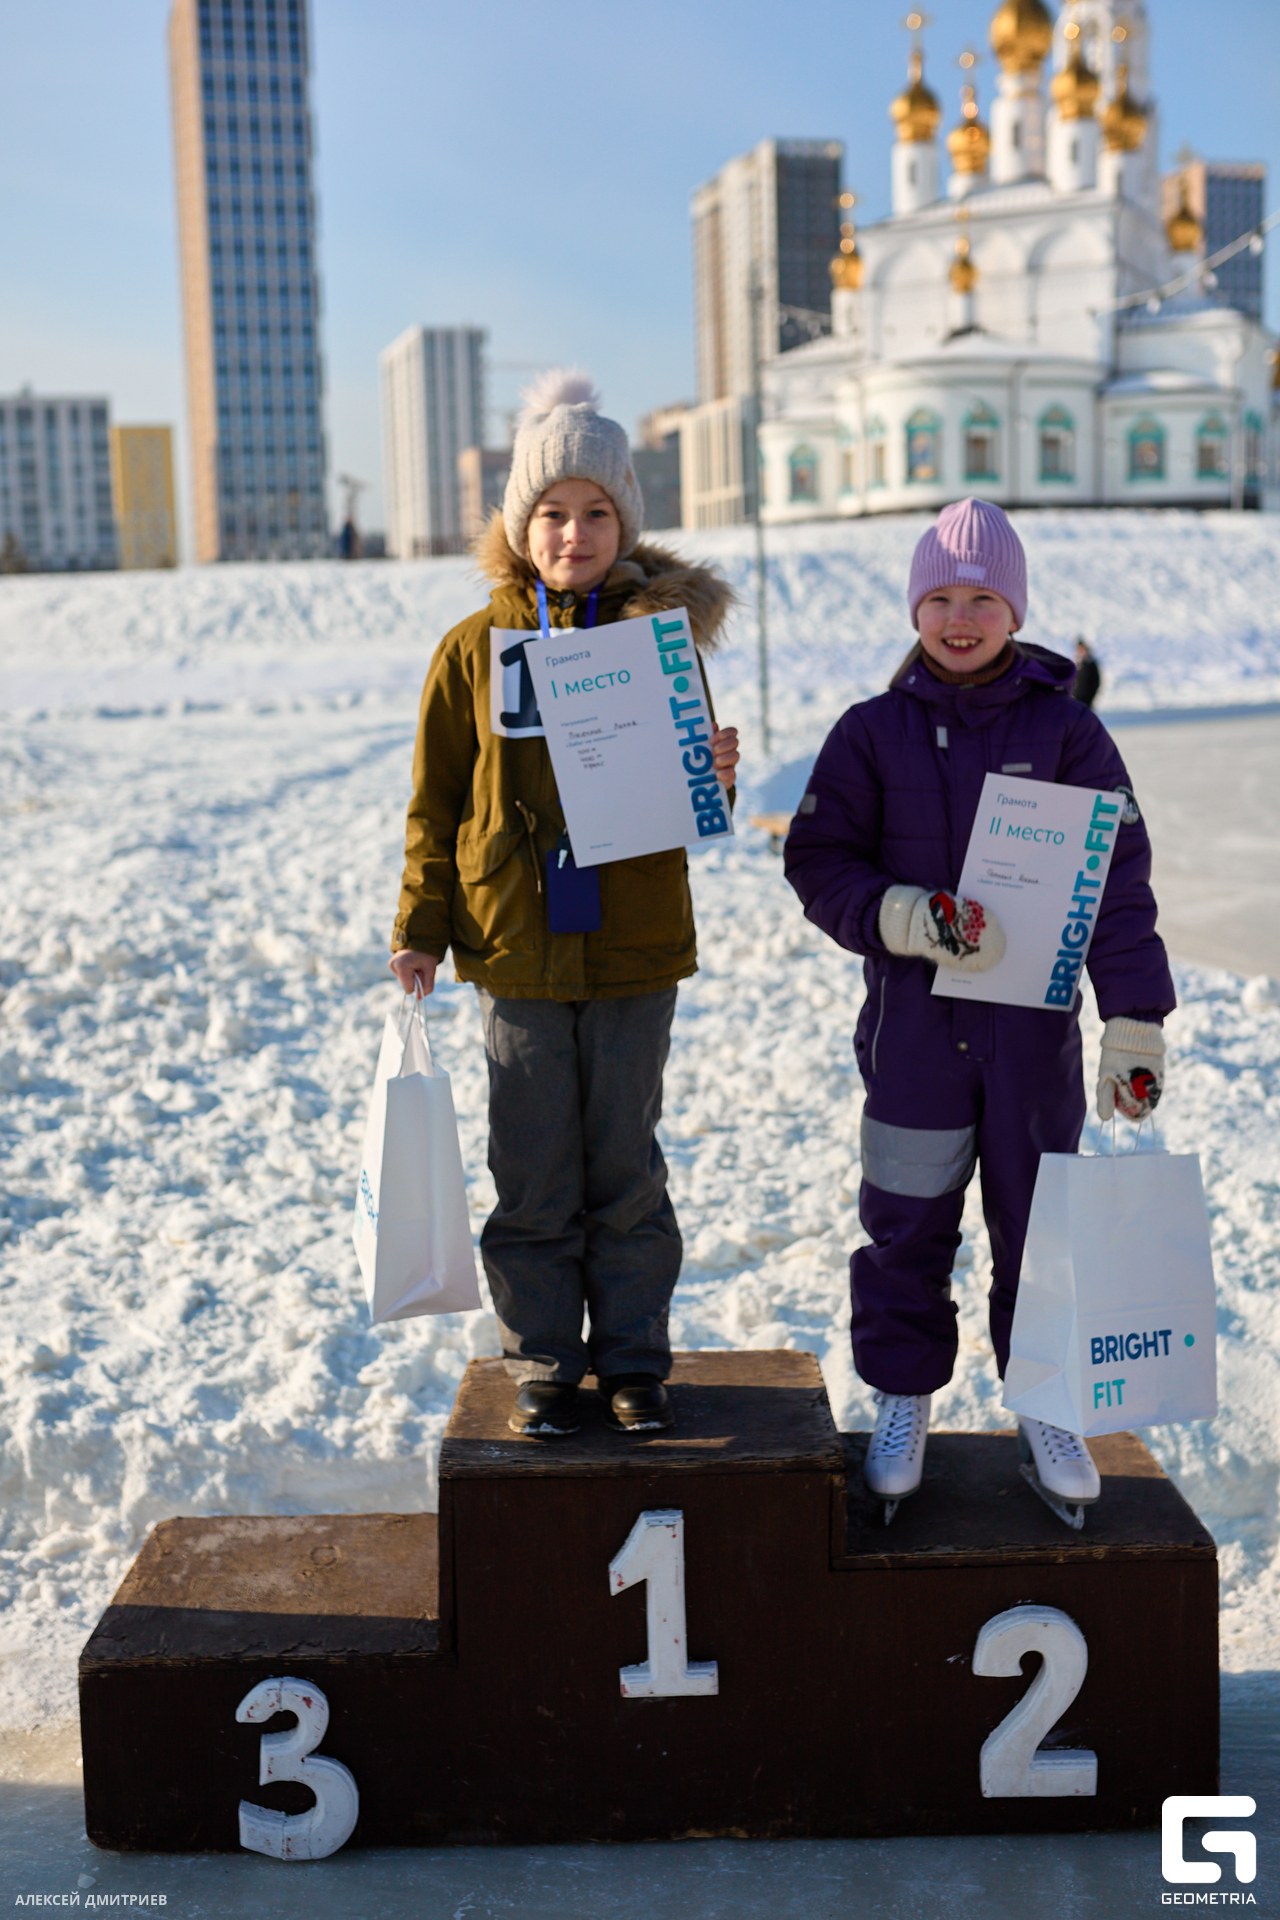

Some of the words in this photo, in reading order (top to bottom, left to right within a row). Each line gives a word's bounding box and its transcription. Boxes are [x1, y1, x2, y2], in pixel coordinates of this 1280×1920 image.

[545, 651, 592, 668] Грамота
[551, 680, 558, 699] I
[565, 669, 631, 697] место
[996, 793, 1038, 810] Грамота
[989, 816, 1002, 836] II
[1006, 823, 1065, 846] место
[1091, 1329, 1172, 1365] BRIGHT
[1094, 1378, 1126, 1409] FIT
[608, 1509, 719, 1698] 1
[972, 1604, 1098, 1798] 2
[235, 1676, 359, 1861] 3
